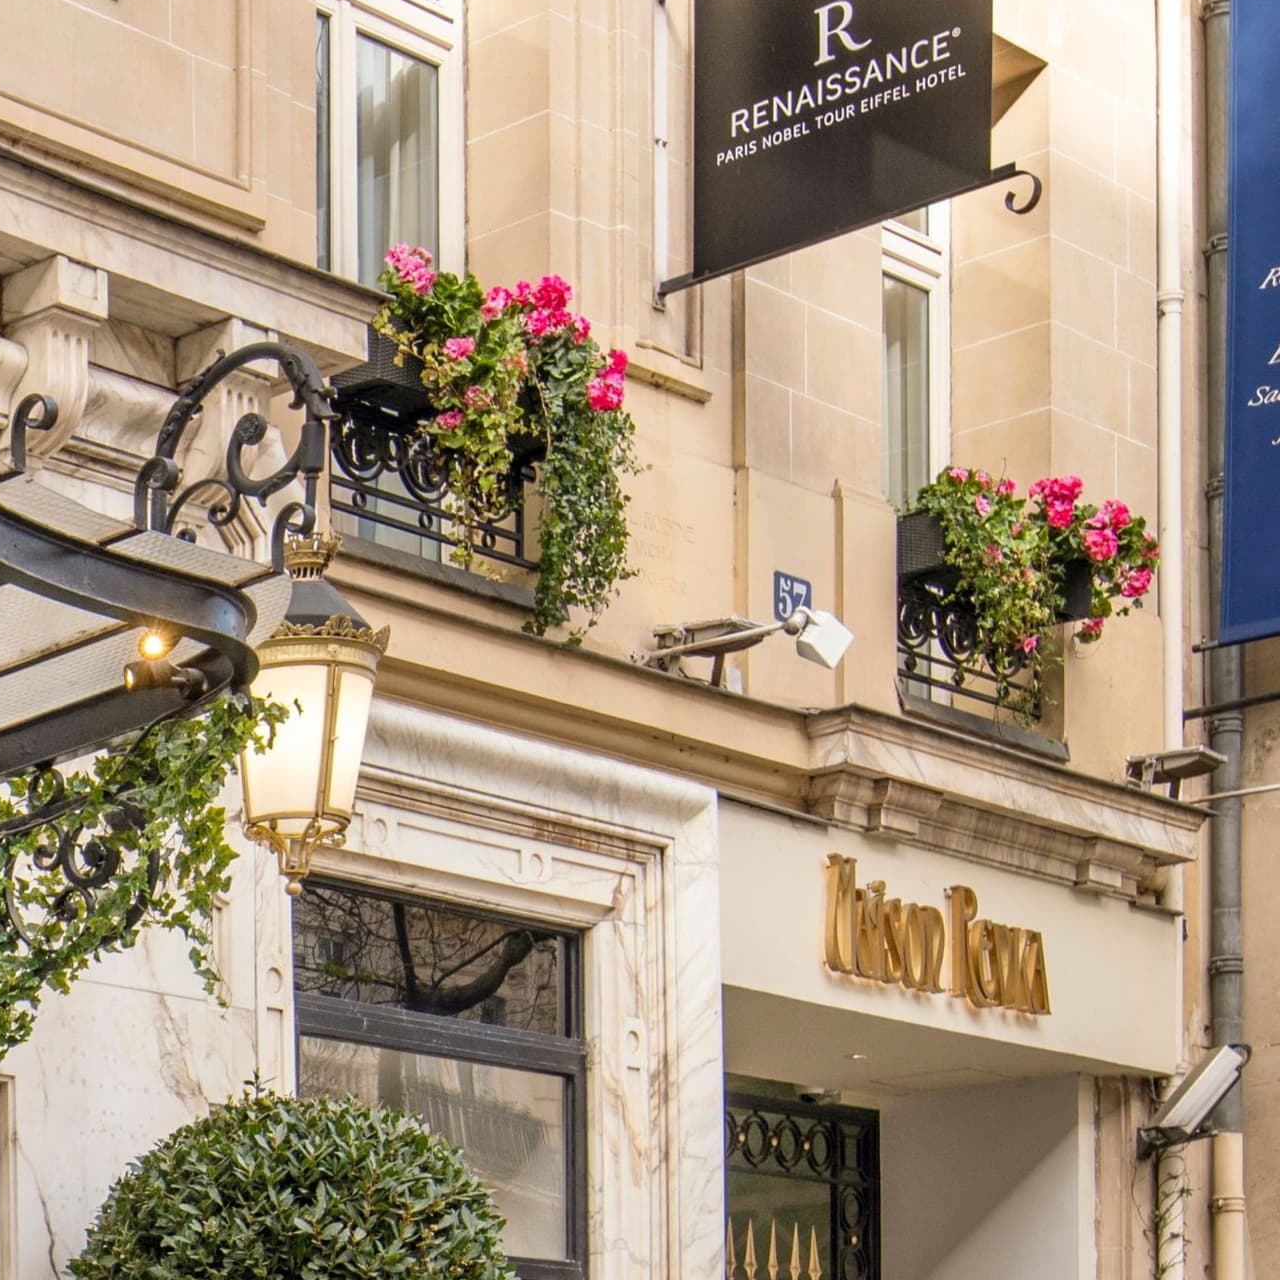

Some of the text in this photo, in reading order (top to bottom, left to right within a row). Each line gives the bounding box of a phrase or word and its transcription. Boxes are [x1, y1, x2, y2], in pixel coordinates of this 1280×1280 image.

[813, 0, 872, 67] R
[716, 63, 966, 167] PARIS NOBEL TOUR EIFFEL HOTEL
[778, 577, 808, 618] 57
